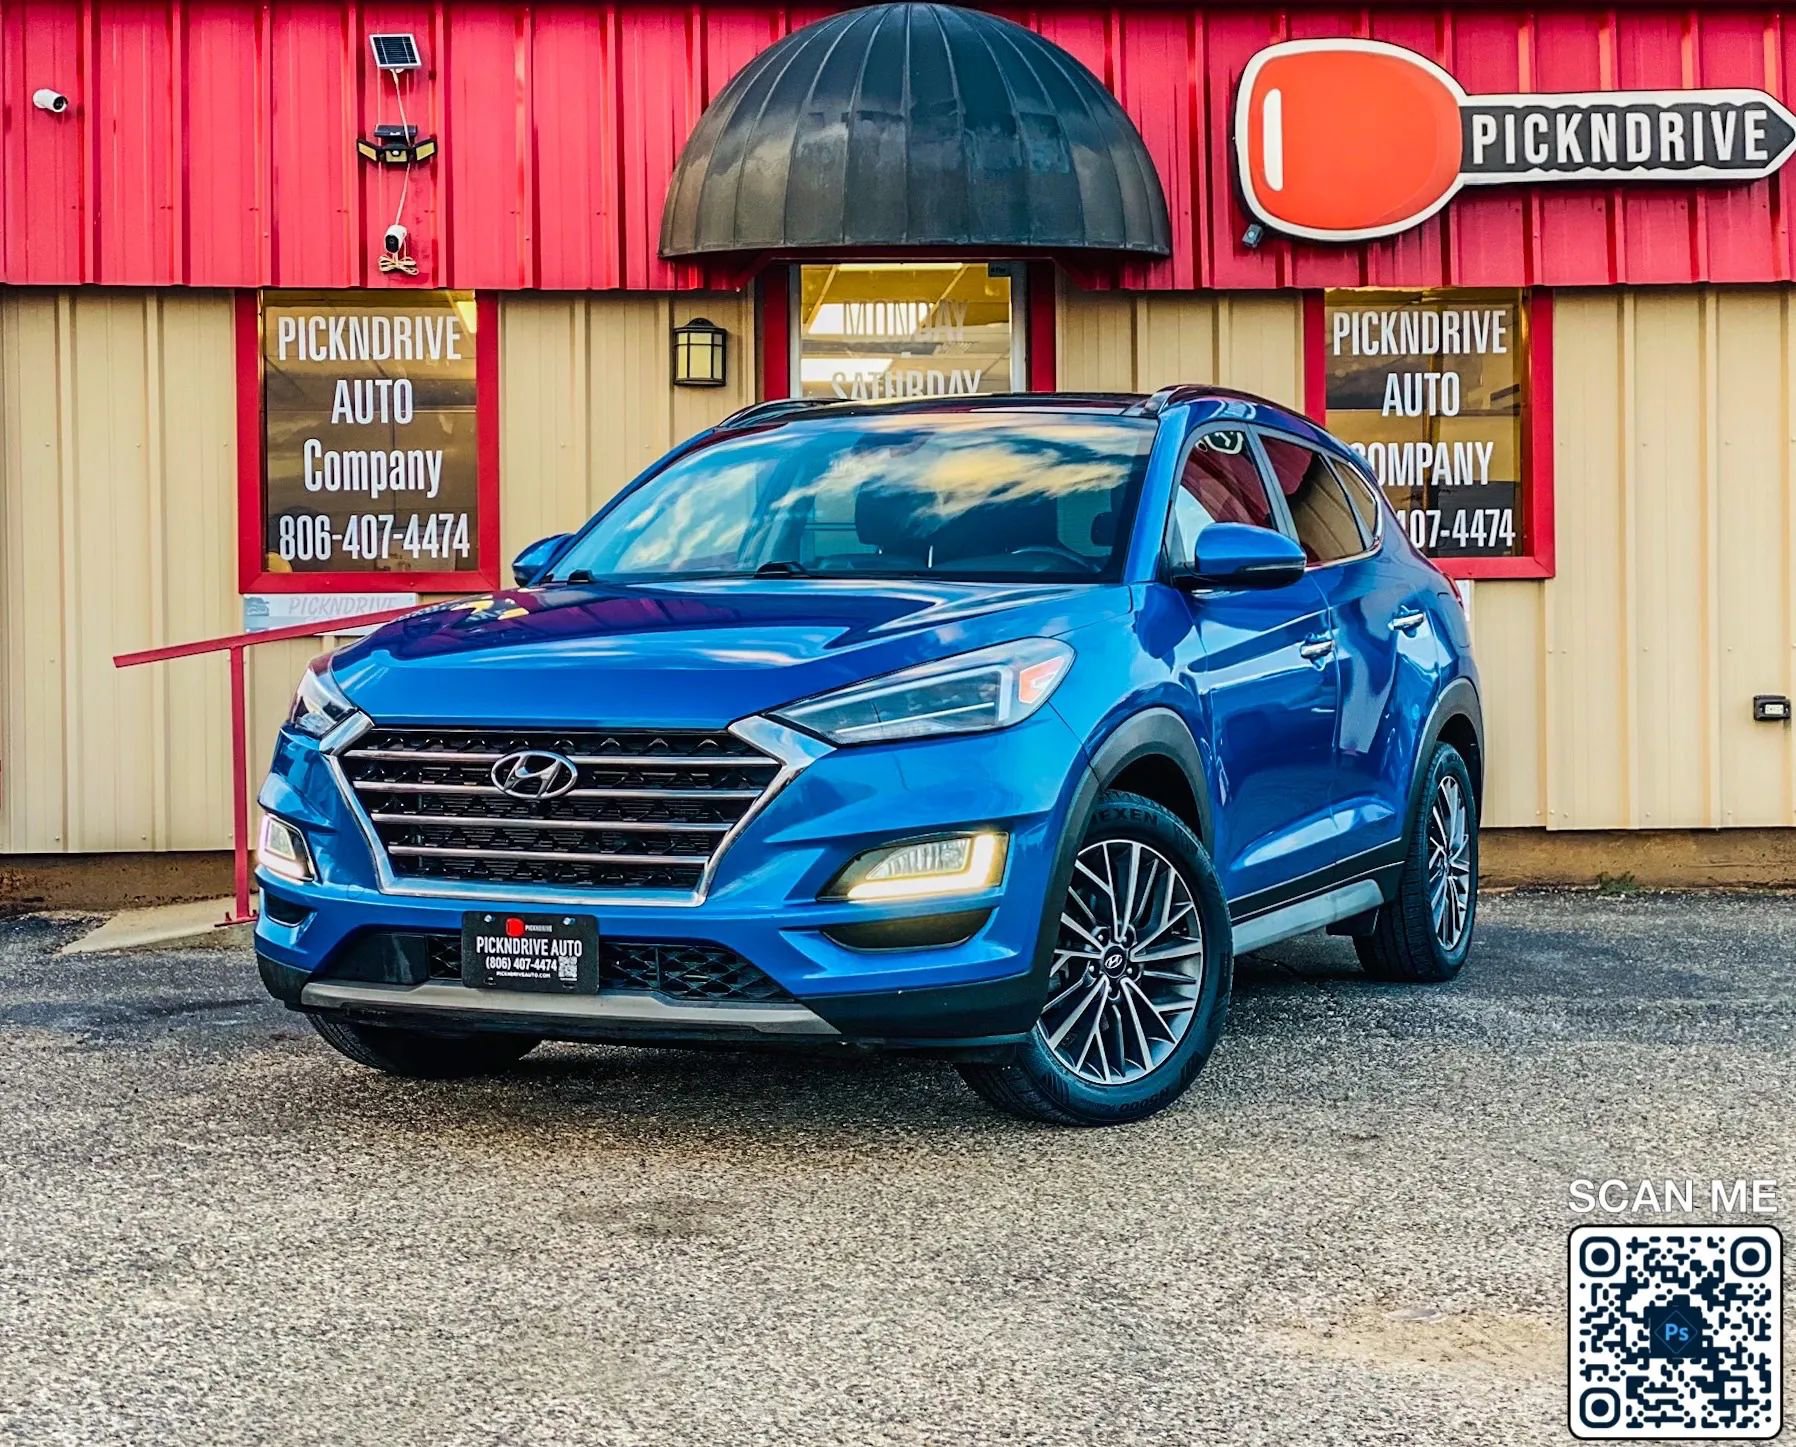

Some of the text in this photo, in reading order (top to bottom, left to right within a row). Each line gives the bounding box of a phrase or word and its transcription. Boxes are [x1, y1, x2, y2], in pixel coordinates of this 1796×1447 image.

[1472, 110, 1768, 164] PICKNDRIVE
[278, 316, 461, 361] PICKNDRIVE
[843, 299, 968, 341] MONDAY
[1333, 310, 1507, 356] PICKNDRIVE
[331, 378, 413, 424] AUTO
[1382, 372, 1460, 417] AUTO
[303, 438, 442, 499] Company
[279, 513, 470, 561] 806-407-4474
[288, 597, 397, 615] PICKNDRIVE
[476, 936, 583, 957] PICKNDRIVE AUTO
[485, 956, 557, 972] (806) 407-4474
